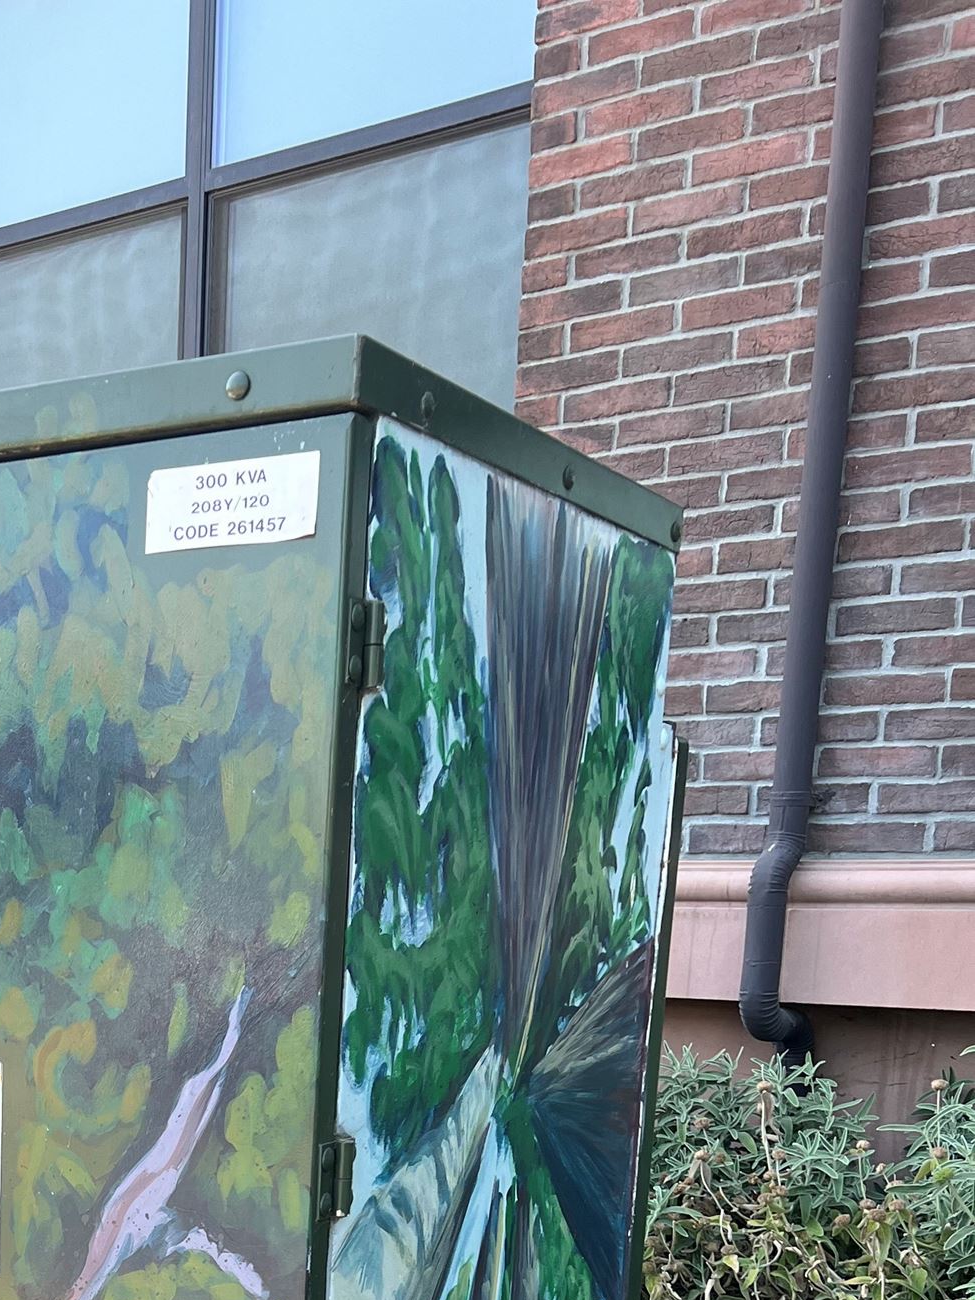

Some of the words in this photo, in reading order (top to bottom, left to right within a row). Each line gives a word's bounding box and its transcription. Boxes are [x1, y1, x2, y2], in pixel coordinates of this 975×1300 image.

[195, 473, 227, 490] 300
[235, 469, 267, 486] KVA
[191, 494, 270, 514] 208Y/120
[173, 523, 219, 541] CODE
[227, 516, 286, 536] 261457
